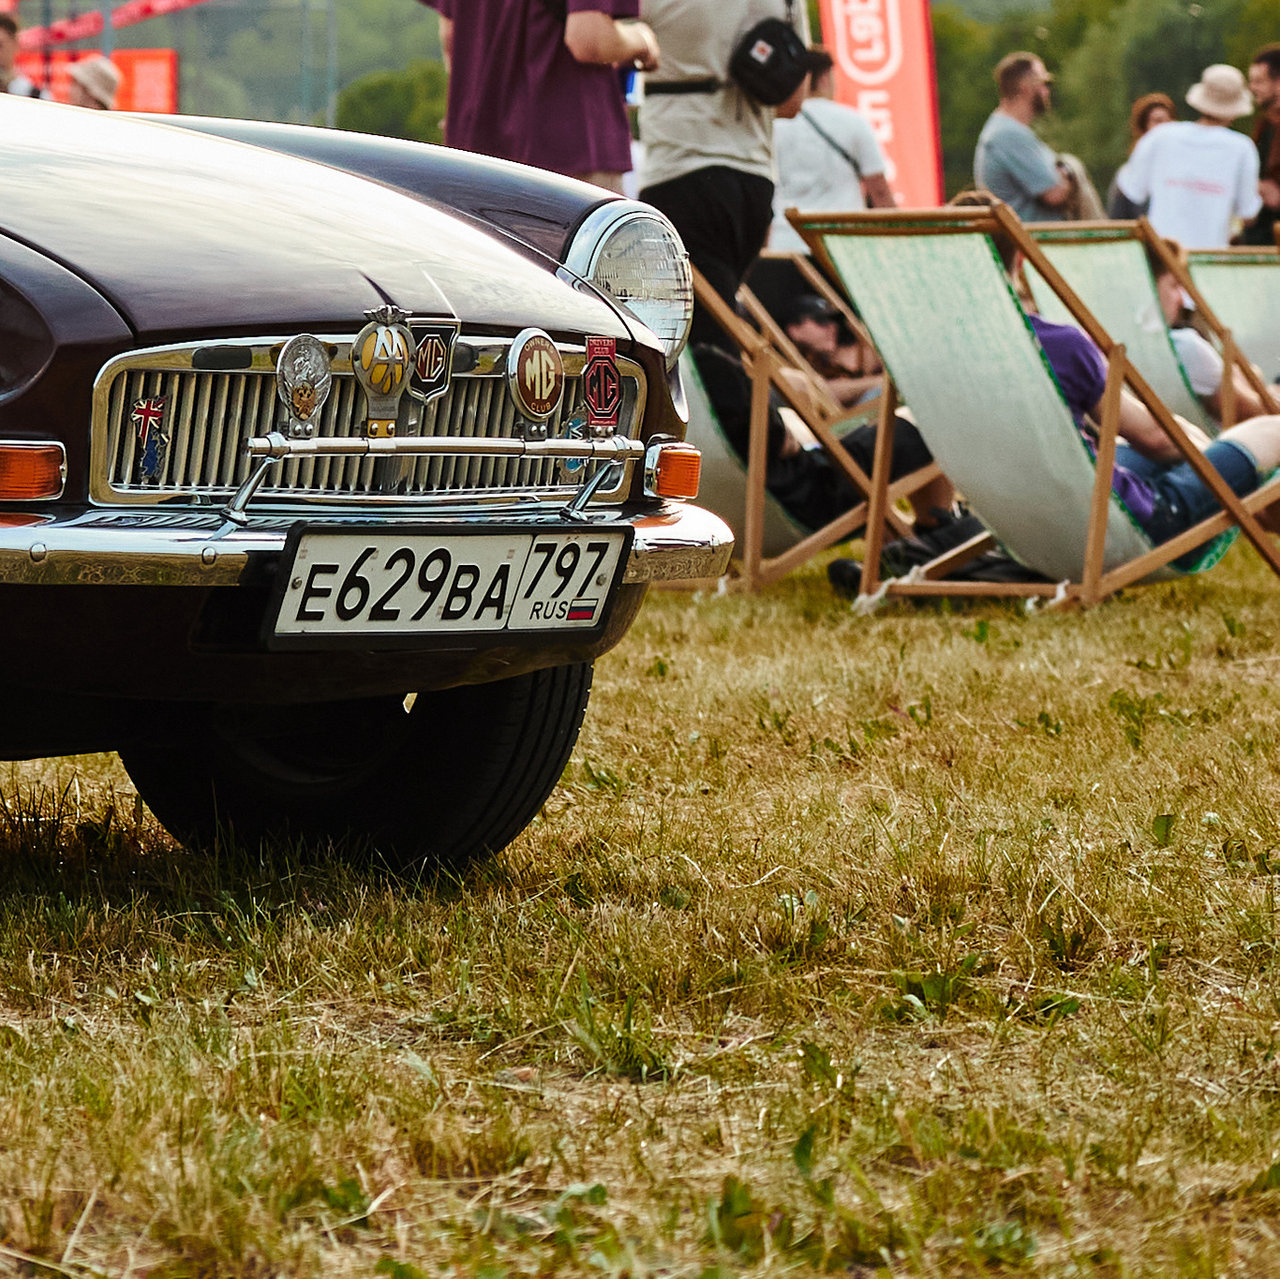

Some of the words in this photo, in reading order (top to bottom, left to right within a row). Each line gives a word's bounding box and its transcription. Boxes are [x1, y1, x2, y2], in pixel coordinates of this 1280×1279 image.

[417, 338, 445, 379] MG
[524, 337, 555, 354] OWNERS
[525, 350, 556, 400] MG
[587, 363, 617, 410] MG
[530, 401, 552, 413] CLUB
[296, 547, 511, 622] E629BA
[524, 542, 610, 599] 797
[529, 599, 569, 620] RUS
